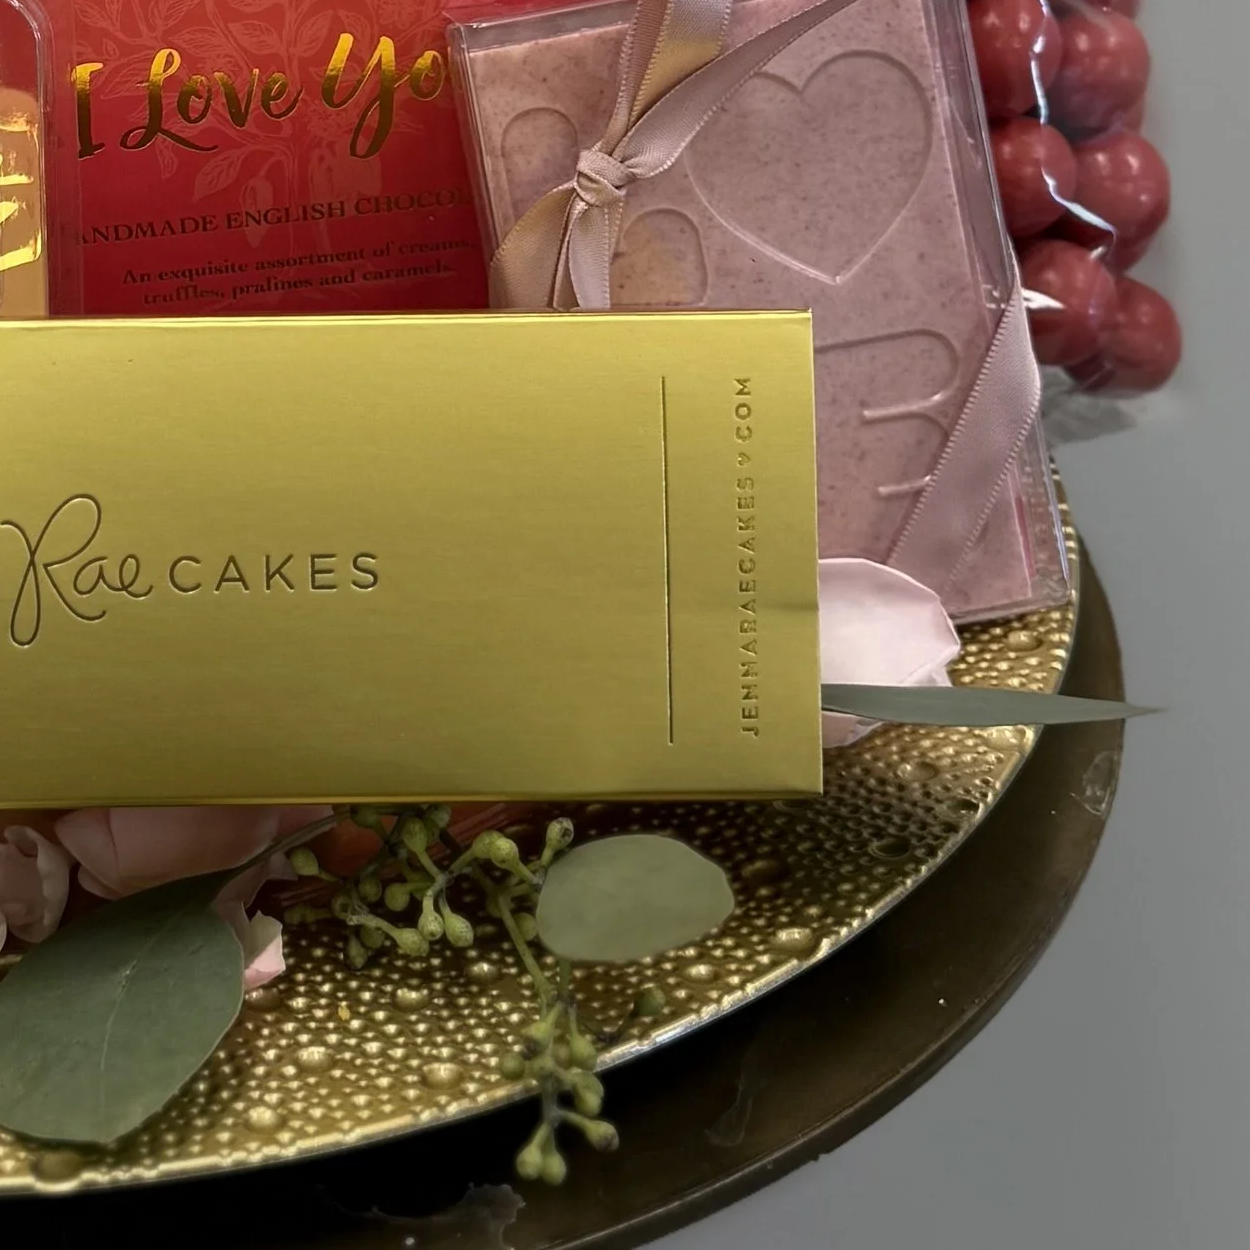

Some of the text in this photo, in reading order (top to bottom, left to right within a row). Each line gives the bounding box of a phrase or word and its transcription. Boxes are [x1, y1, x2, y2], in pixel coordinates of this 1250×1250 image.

[70, 33, 450, 161] I Love Yo
[225, 200, 347, 228] ENGLISH
[122, 268, 152, 285] An
[157, 260, 248, 285] exquisite
[254, 249, 367, 273] assortment
[373, 240, 396, 259] of
[232, 277, 314, 301] pralines
[318, 269, 357, 286] and
[0, 492, 155, 648] Rae
[167, 552, 380, 595] CAKES
